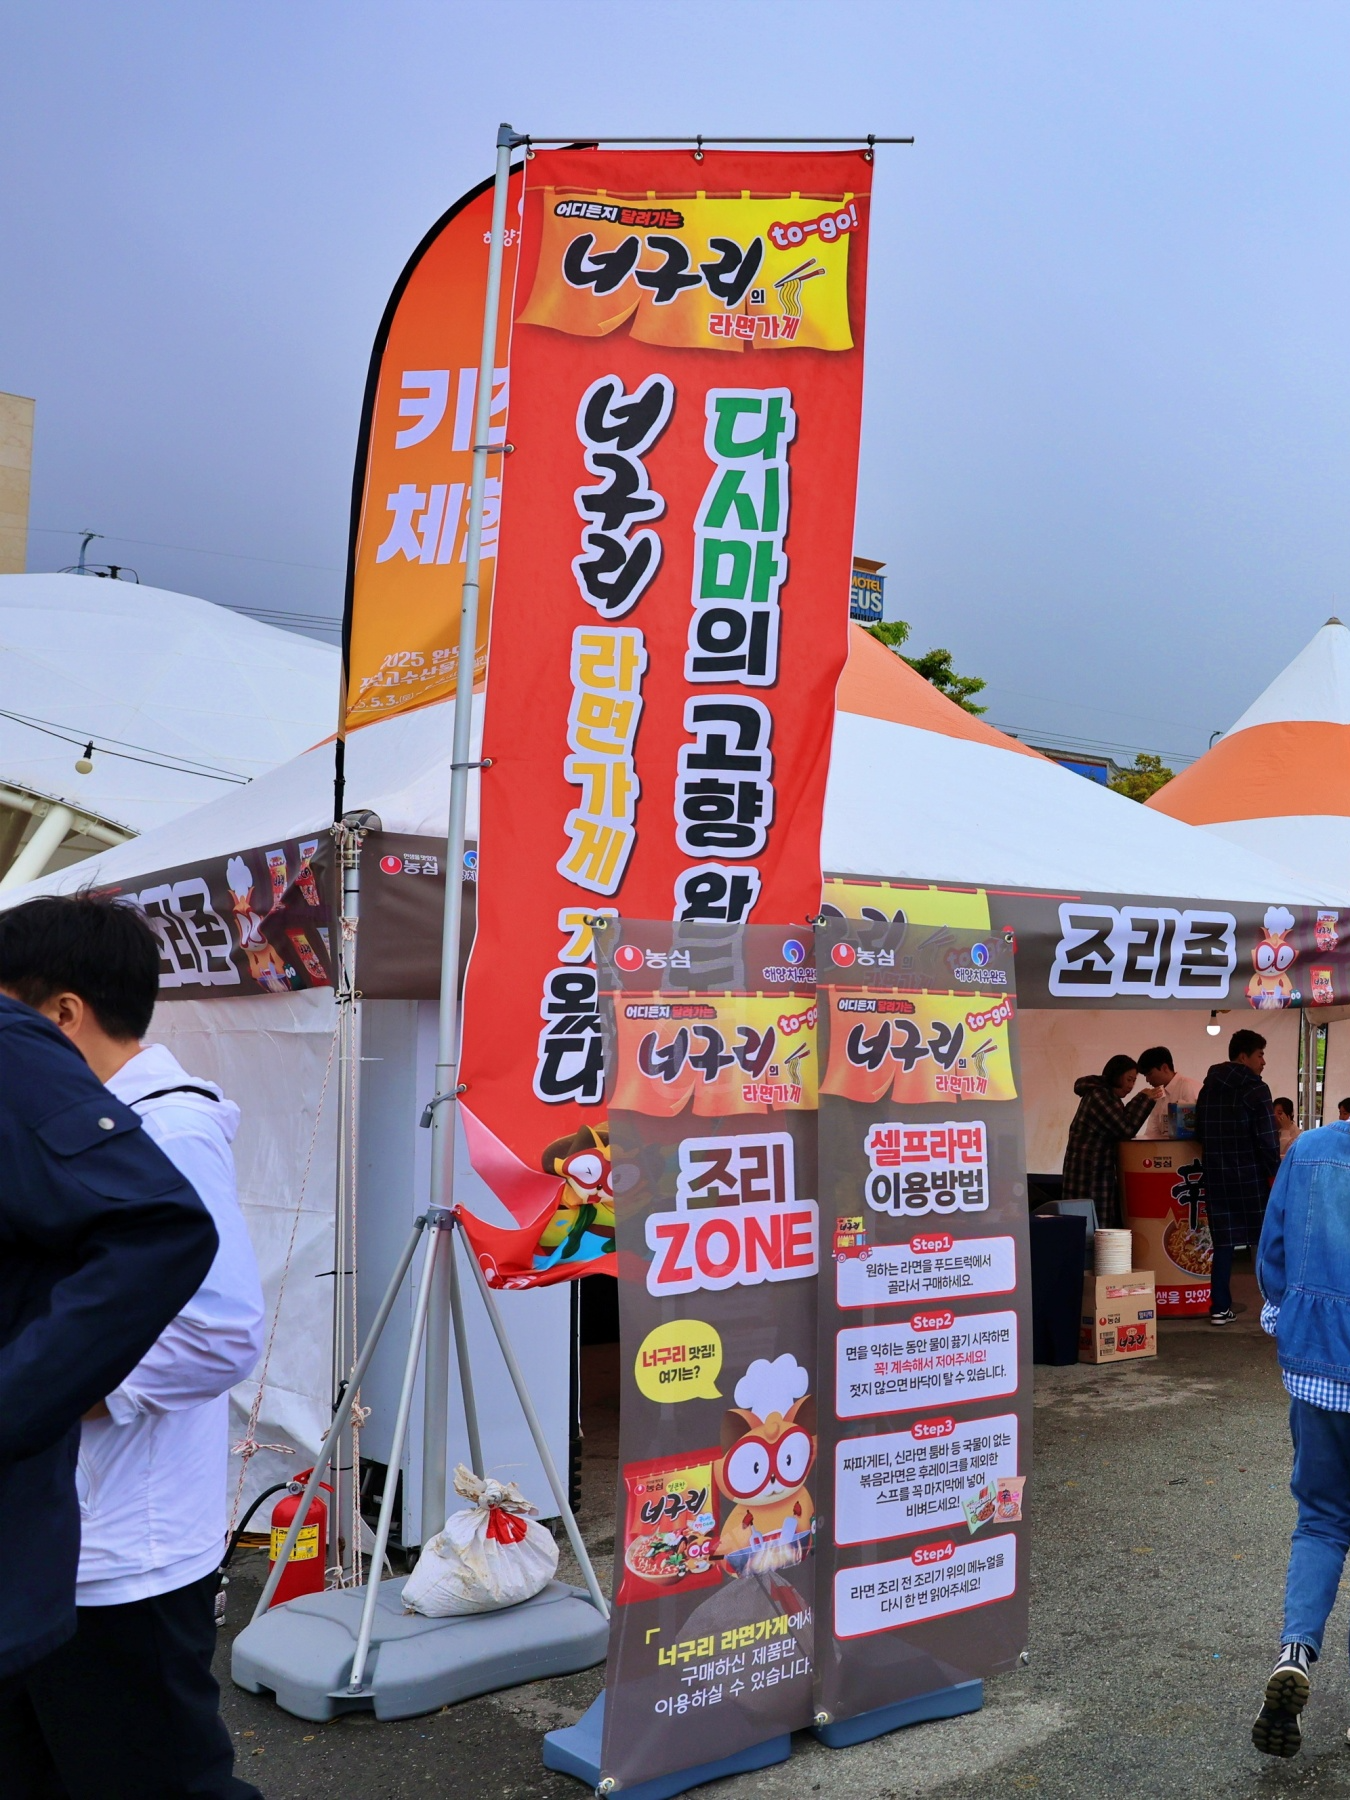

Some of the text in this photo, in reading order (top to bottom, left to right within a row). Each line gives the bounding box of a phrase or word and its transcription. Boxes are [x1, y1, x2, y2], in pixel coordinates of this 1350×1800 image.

[554, 202, 683, 227] 어디든지 달려가는
[770, 204, 860, 248] to-go!
[562, 232, 766, 309] 너구리
[708, 312, 801, 341] 라면가게
[579, 379, 671, 612] 너구리
[690, 393, 790, 679] 다시마의
[564, 631, 641, 889] 라면가게
[680, 703, 770, 849] 고향
[403, 859, 439, 876] 농심
[645, 948, 691, 969] 농심
[856, 947, 895, 967] 농심
[1055, 914, 1232, 989] 조리존
[954, 968, 1007, 985] 해양치유완도
[625, 1005, 717, 1019] 어디든지 달려가는
[838, 999, 915, 1014] 어디든지 달려가는
[967, 1000, 1013, 1029] to-go!
[636, 1022, 776, 1084] 너구리
[846, 1018, 965, 1072] 너구리
[742, 1082, 801, 1104] 라면가게
[935, 1075, 988, 1095] 라면가게
[870, 1127, 983, 1167] 셀프라면
[686, 1143, 787, 1211] 조리
[1153, 1159, 1172, 1169] 농심
[871, 1168, 984, 1210] 이용방법
[655, 1210, 815, 1284] ZONE
[912, 1237, 951, 1252] Step1
[866, 1254, 992, 1278] 원하는 라면을 푸드트럭에서
[887, 1274, 974, 1295] 골라서 구매하세요.
[913, 1313, 952, 1330] Step2
[1107, 1315, 1121, 1325] 농심
[846, 1328, 1010, 1361] 면을 익히는 동안 물이 끓기 시작하면
[1119, 1334, 1145, 1348] 너구리
[642, 1344, 715, 1368] 너구리 맛집!
[874, 1349, 987, 1375] 꼭! 계속해서 저어주세요!
[659, 1365, 701, 1384] 여기는?
[850, 1364, 1007, 1398] 젓지 않으면 바닥이 탈 수 있습니다.
[914, 1420, 952, 1437] Step3
[843, 1432, 1011, 1472] 짜파게티, 신라면 툼바 등 국물이 없는
[859, 1452, 999, 1488] 볶음라면은 후레이크를 제외한
[646, 1483, 664, 1493] 농심
[876, 1472, 985, 1504] 스프를 꼭 마지막에 넣어
[640, 1487, 709, 1525] 너구리
[906, 1495, 960, 1518] 비벼드세요!
[914, 1543, 952, 1563] Step4
[850, 1553, 1005, 1600] 라면 조리 전 조리기 위의 메뉴얼을
[881, 1577, 981, 1613] 다시 한 번 읽어주세요!
[720, 1607, 812, 1651] 라면가게에서
[681, 1637, 798, 1687] 구매하신 제품만
[655, 1656, 813, 1717] 이용하실 수 있습니다.
